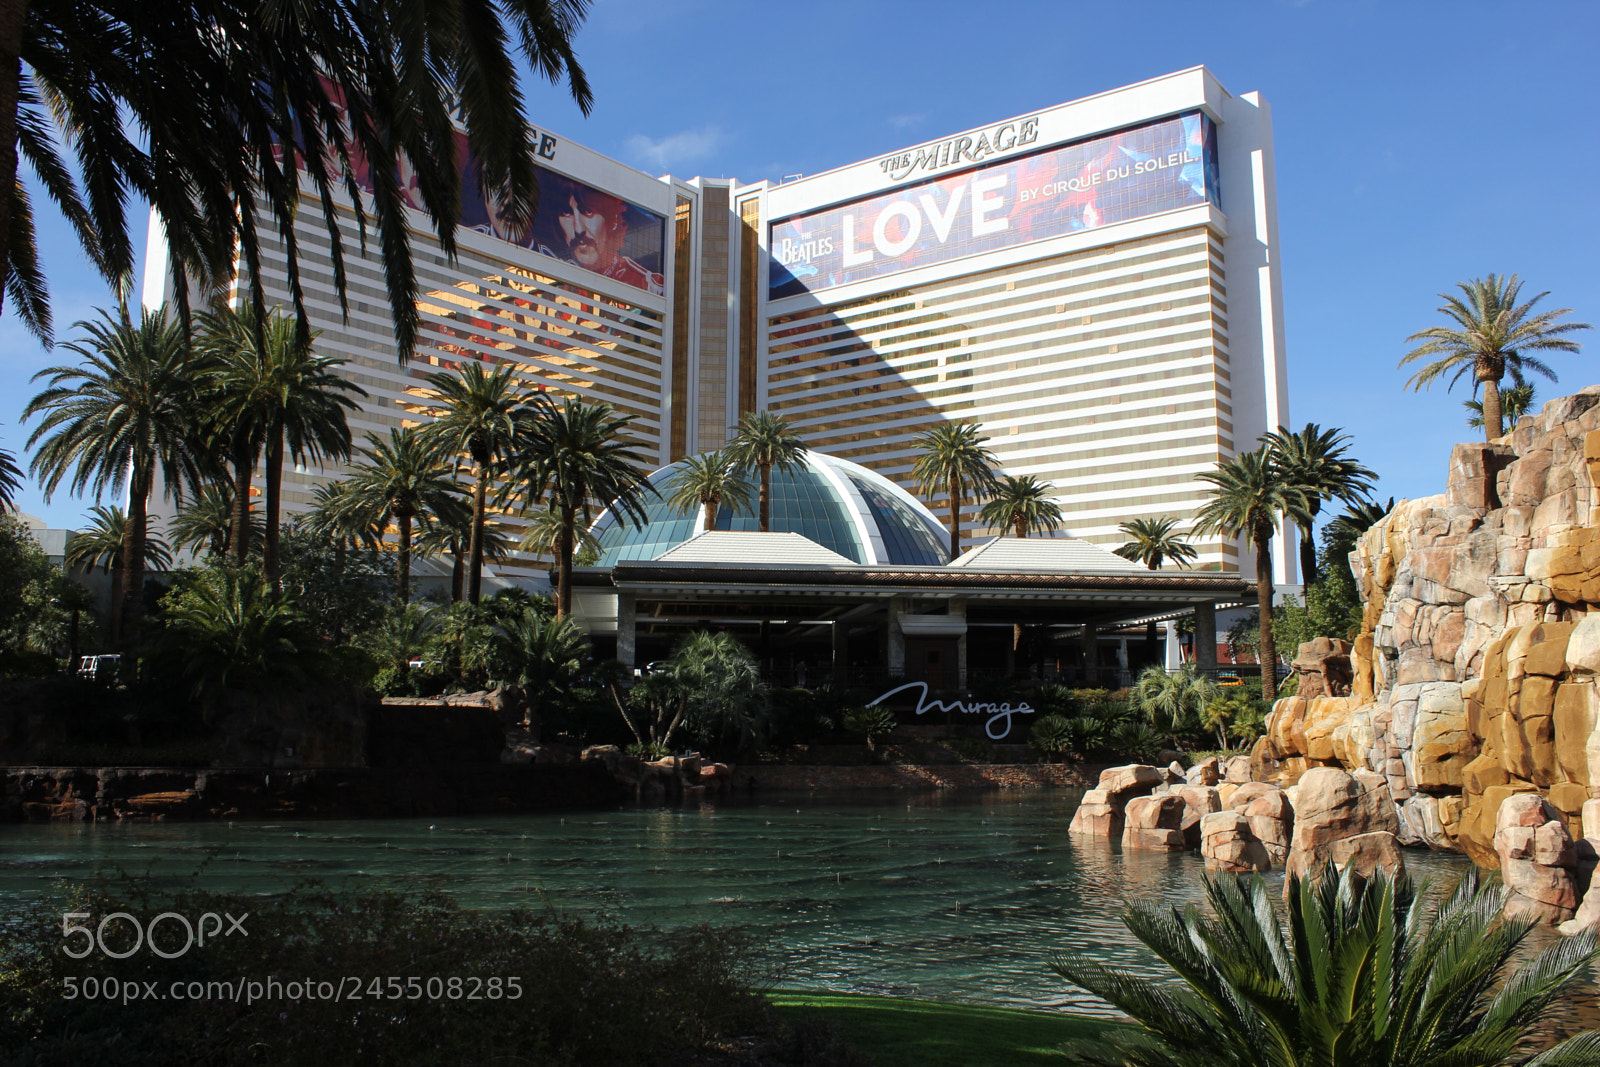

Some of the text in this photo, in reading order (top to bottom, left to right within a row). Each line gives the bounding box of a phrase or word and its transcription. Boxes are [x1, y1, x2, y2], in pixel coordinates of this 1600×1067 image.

[879, 117, 1039, 180] THE MIRAGE
[1020, 151, 1195, 203] BY CIRQUE DU SOLEIL
[842, 174, 1009, 268] LOVE
[781, 236, 834, 266] BEATLES
